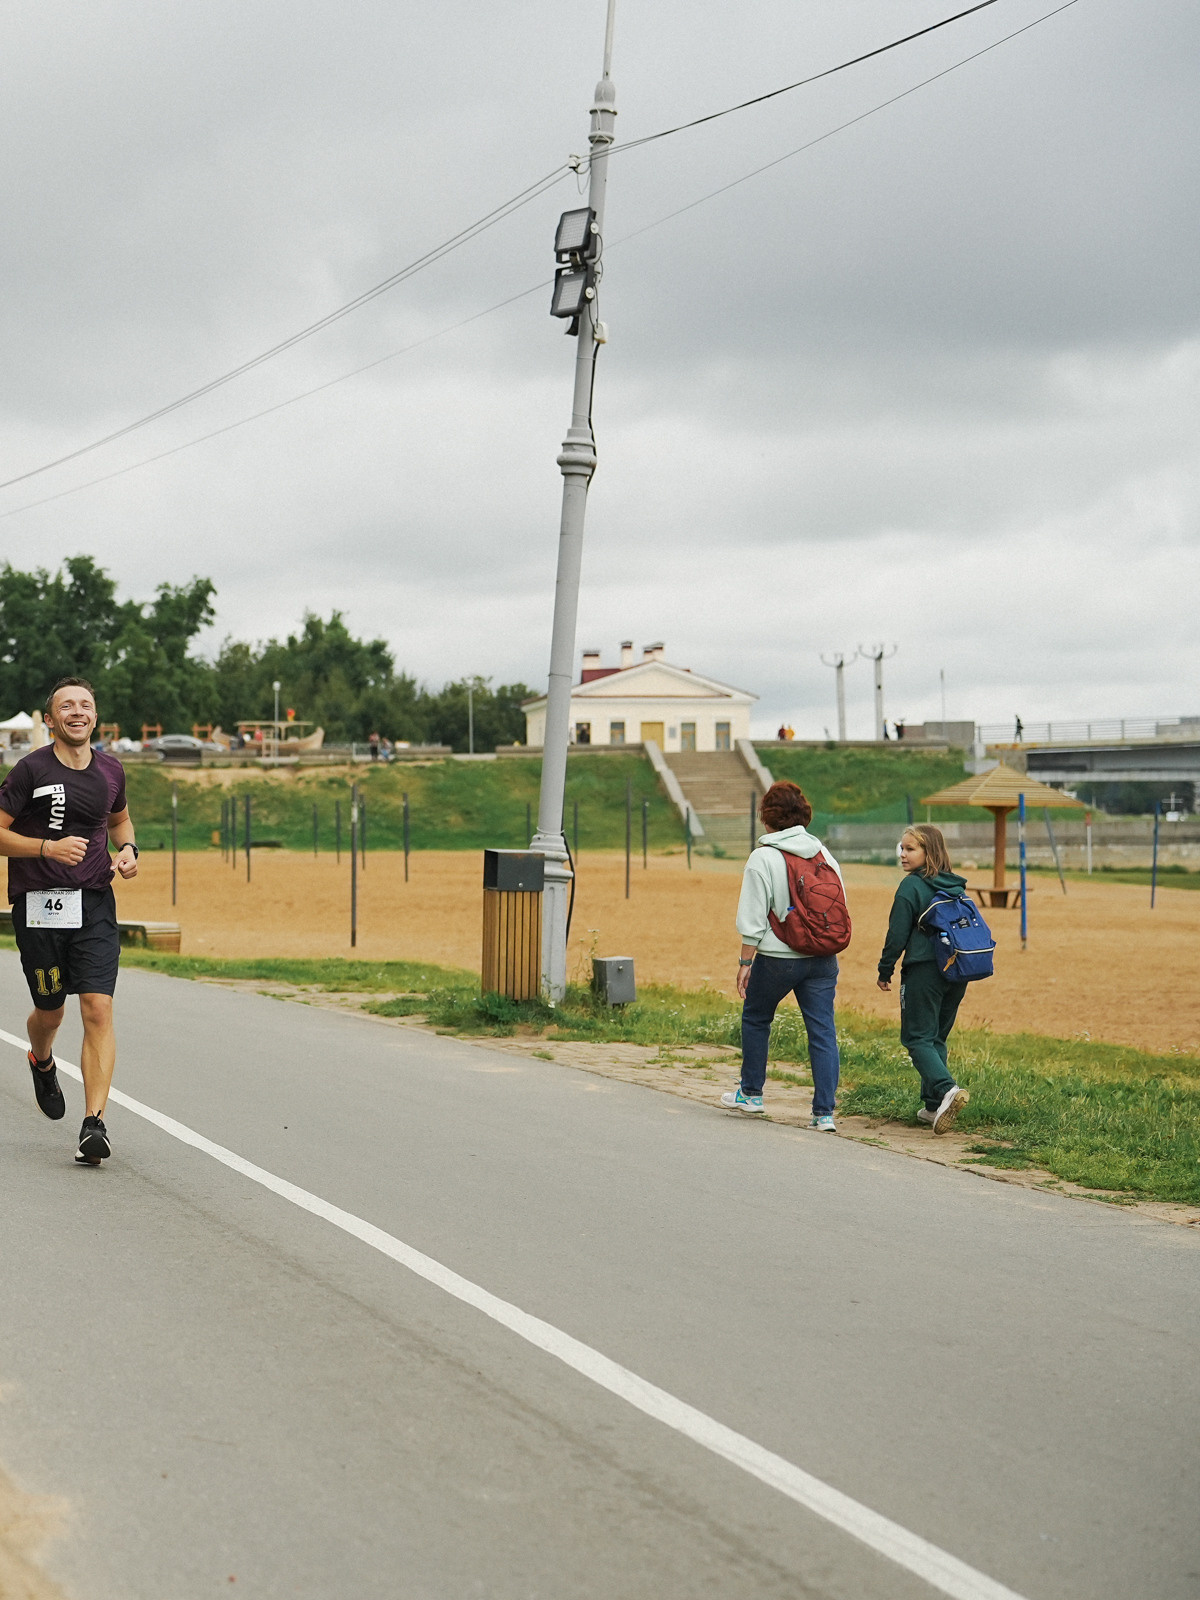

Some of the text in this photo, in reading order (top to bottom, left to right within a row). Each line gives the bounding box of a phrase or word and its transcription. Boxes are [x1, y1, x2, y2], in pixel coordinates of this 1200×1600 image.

[48, 793, 66, 830] RUN
[44, 898, 63, 911] 46
[35, 965, 62, 996] 11
